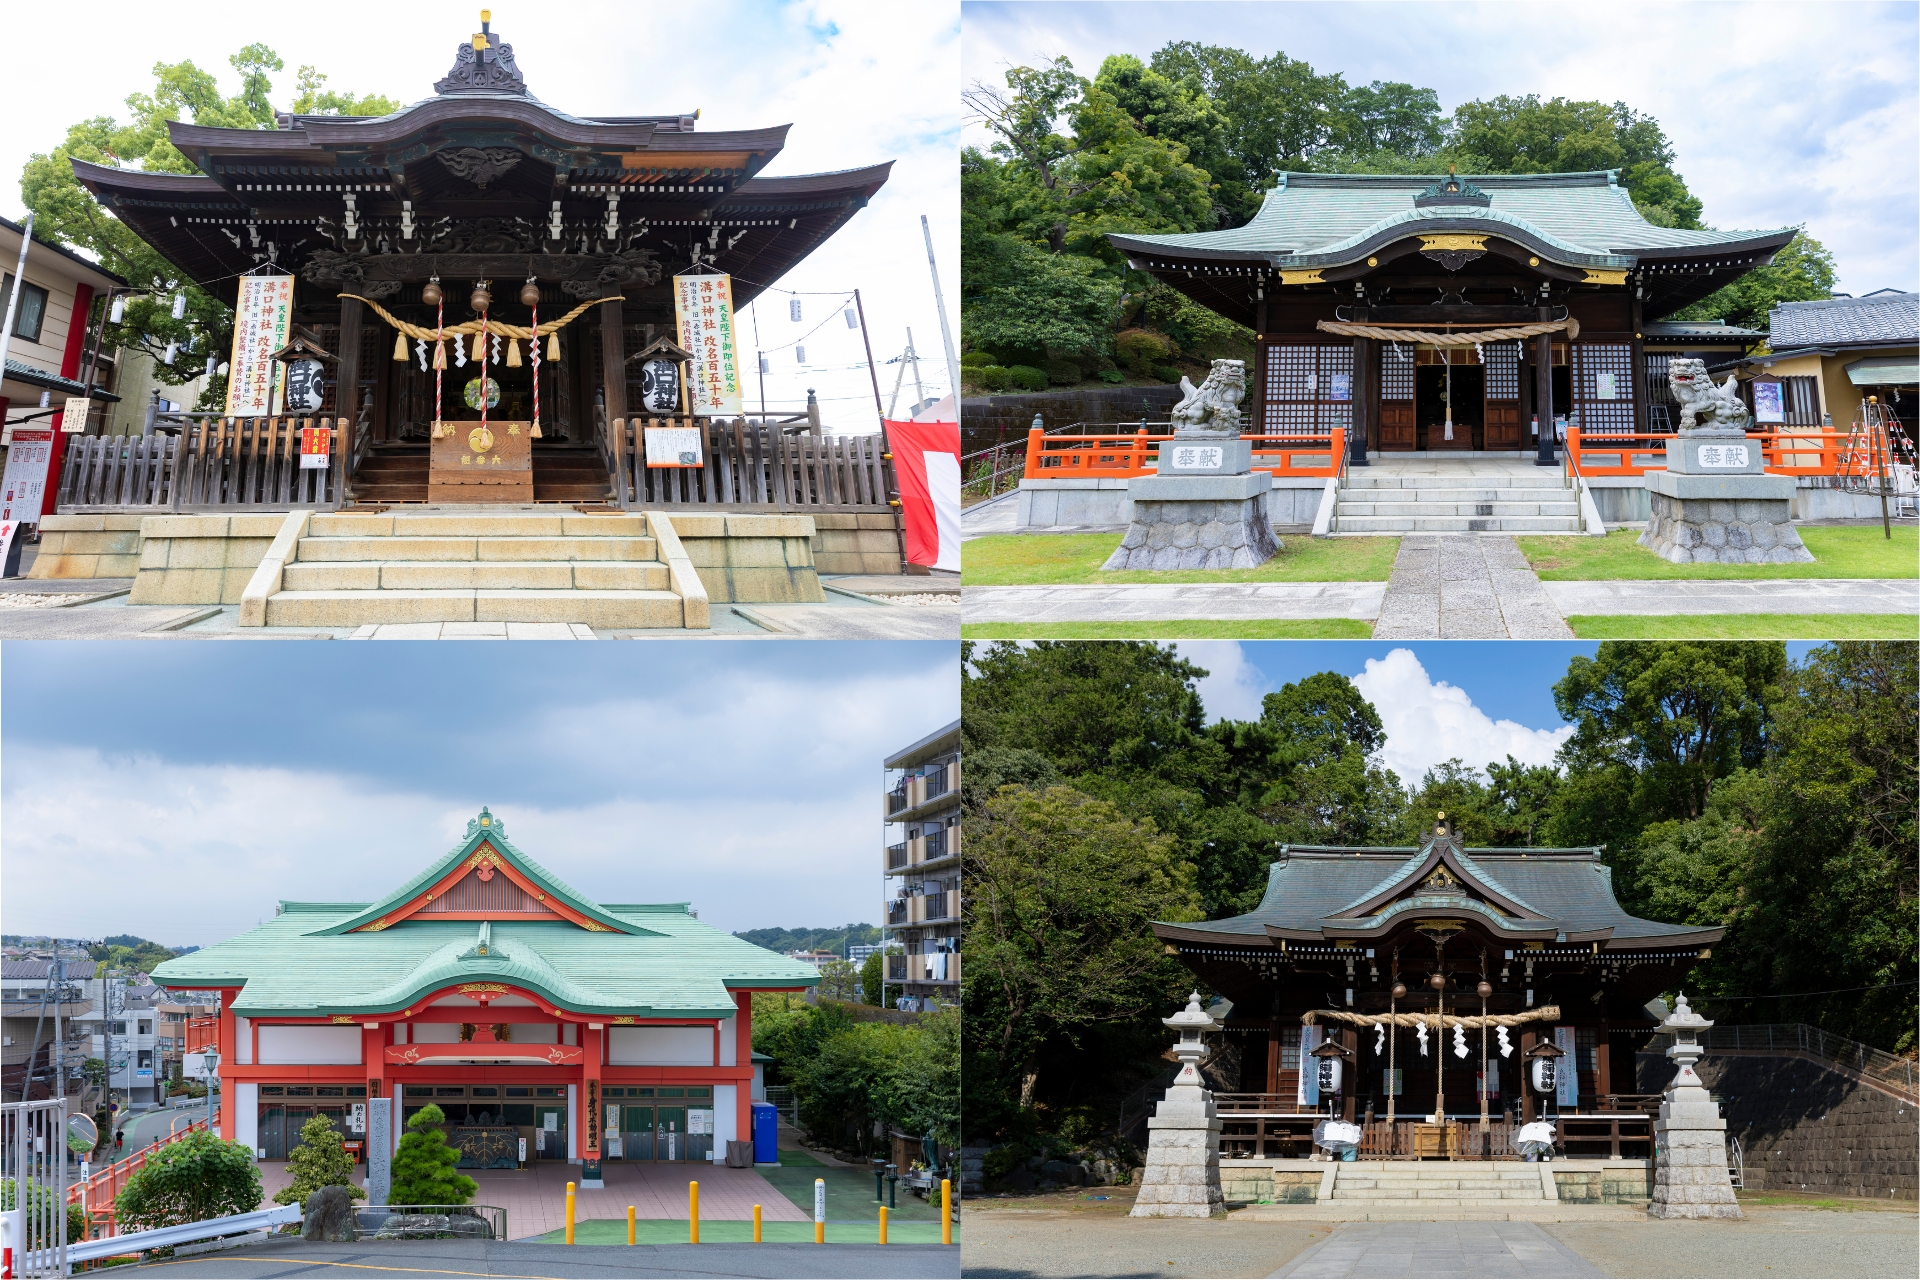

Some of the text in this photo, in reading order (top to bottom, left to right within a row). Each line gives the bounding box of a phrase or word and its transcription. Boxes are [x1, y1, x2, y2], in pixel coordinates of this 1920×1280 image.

[279, 281, 289, 301] 奉祝
[678, 281, 690, 312] 記念事業
[689, 281, 699, 308] 明治6年
[251, 281, 277, 410] 溝口神社 改名百五十年
[699, 281, 724, 410] 溝口神社 改名百五十年
[716, 280, 737, 393] 奉祝 天皇陛下御即位記念
[441, 423, 521, 437] 奉 納
[1177, 448, 1218, 467] 奉献
[1703, 446, 1745, 466] 奉献
